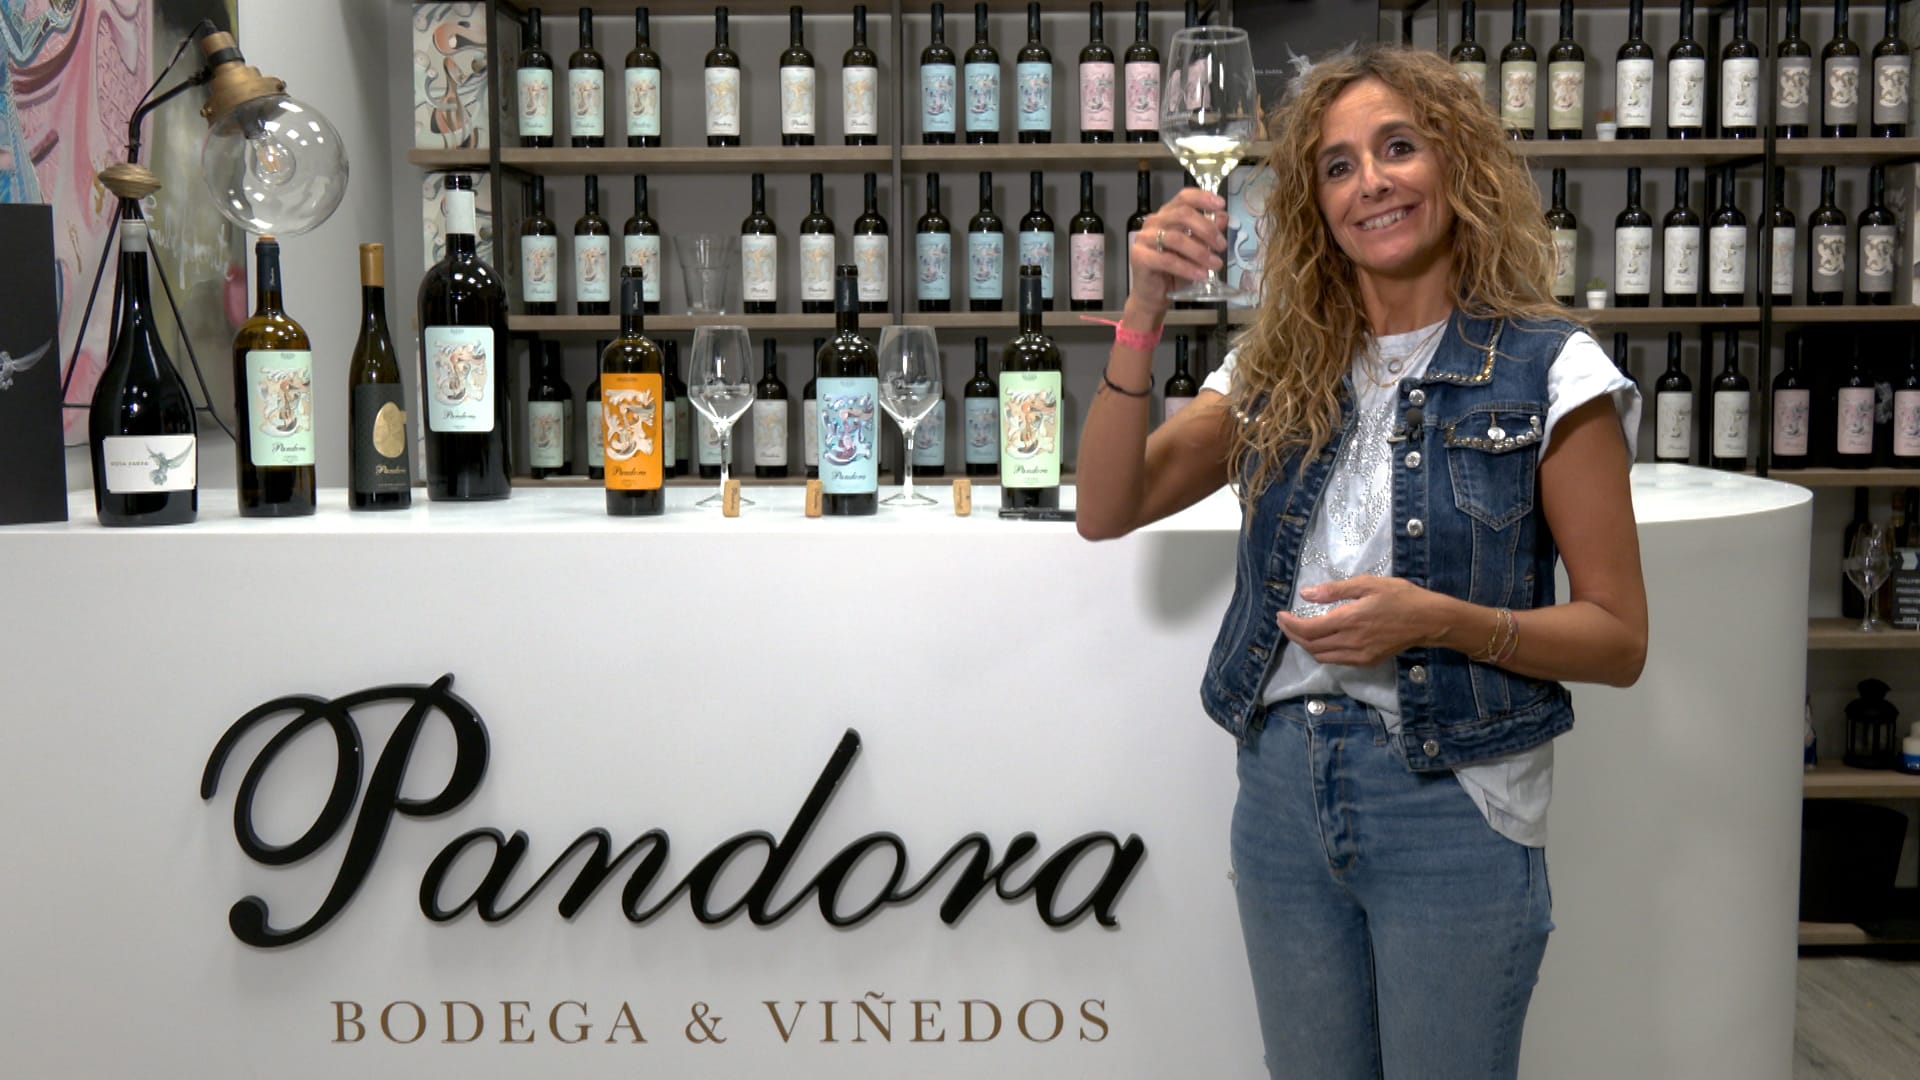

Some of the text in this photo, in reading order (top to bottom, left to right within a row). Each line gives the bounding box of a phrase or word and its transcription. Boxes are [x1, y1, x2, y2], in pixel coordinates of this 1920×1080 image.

[200, 672, 1146, 949] Pandora
[331, 991, 1111, 1043] BODEGA & VIÑEDOS
